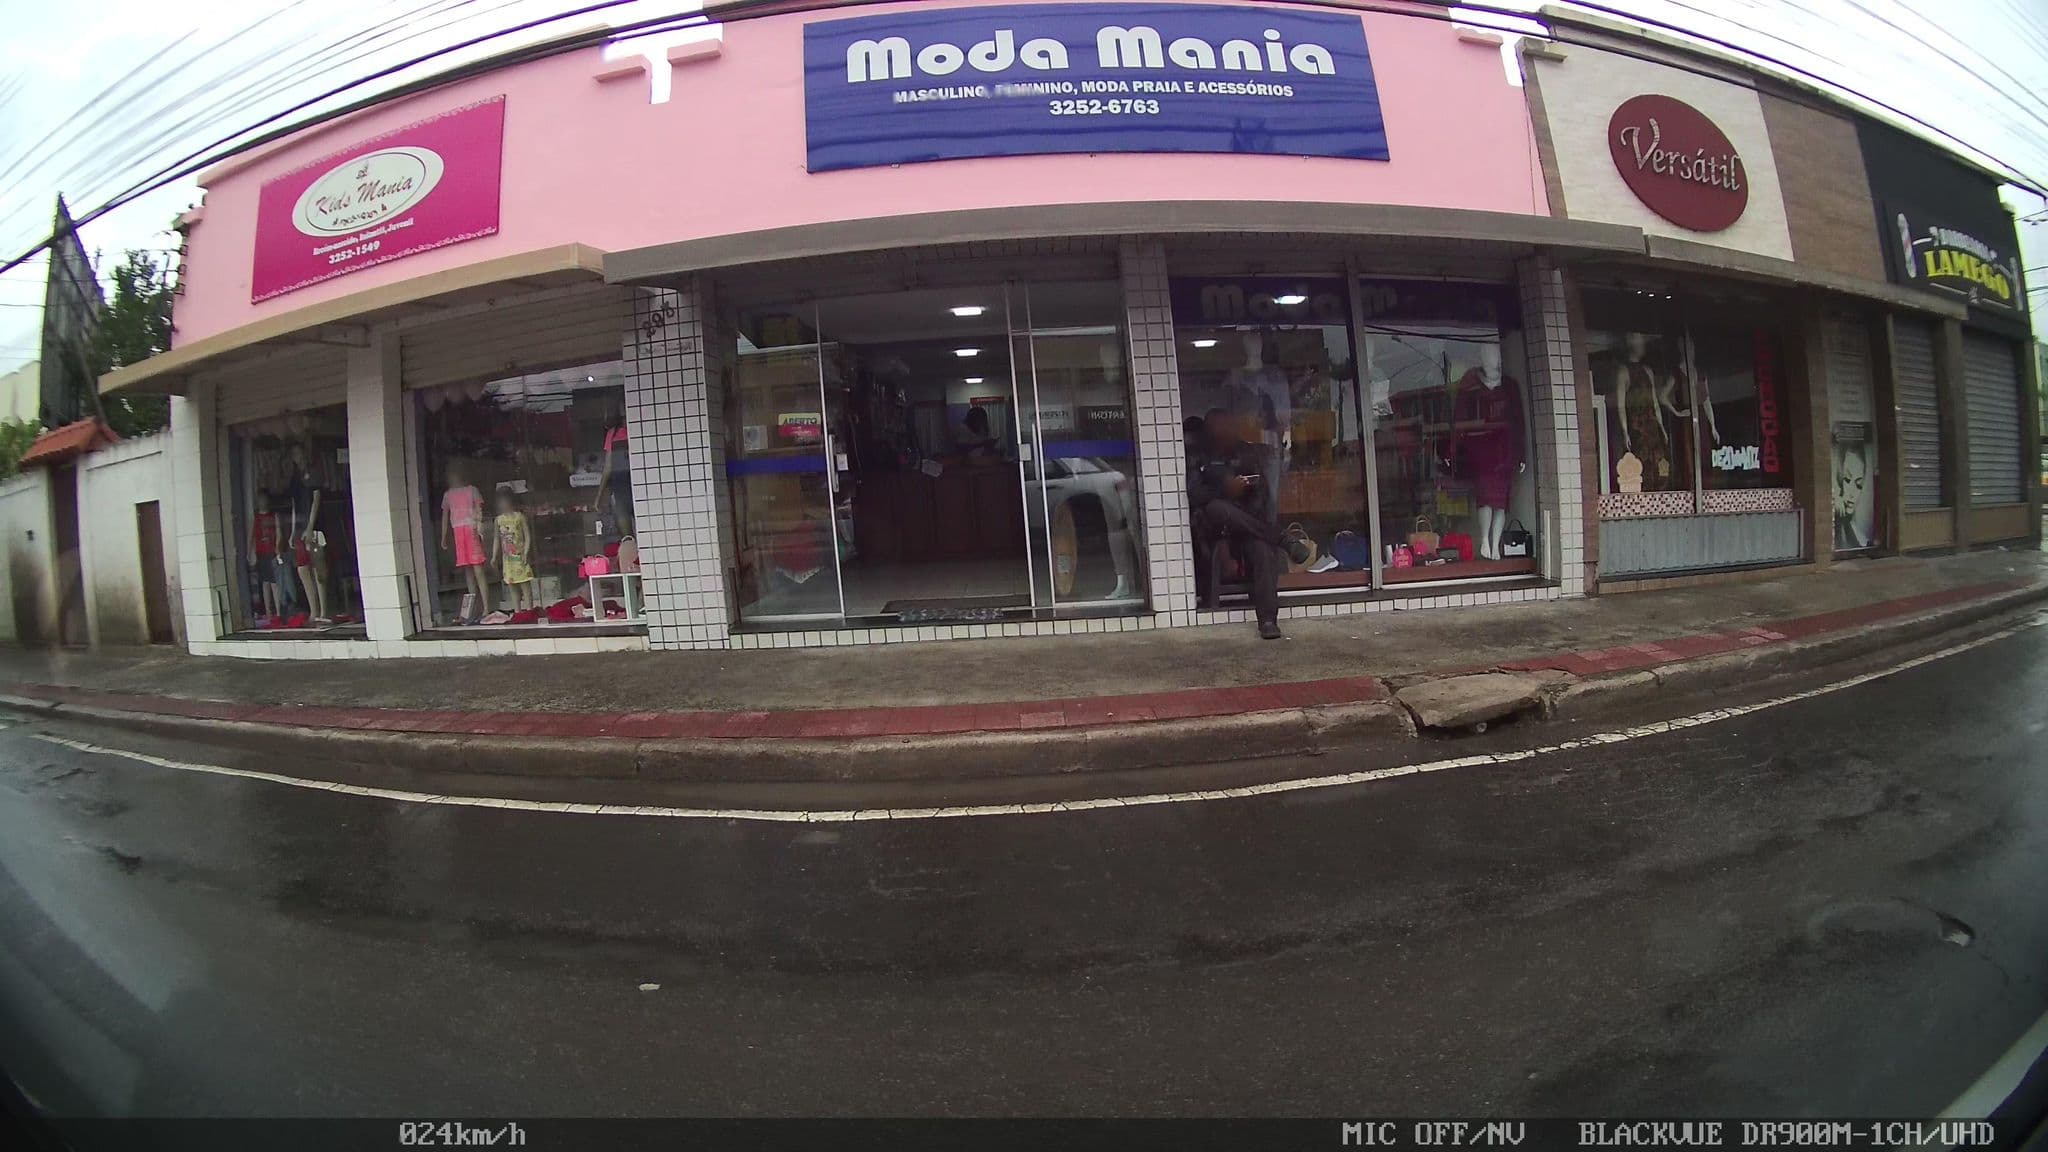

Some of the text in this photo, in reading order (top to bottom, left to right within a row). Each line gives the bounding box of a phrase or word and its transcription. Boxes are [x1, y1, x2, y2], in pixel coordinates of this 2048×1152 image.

[847, 25, 1336, 83] Moda Mania
[893, 85, 990, 104] MASCULINO,
[1081, 80, 1129, 94] MODA
[1132, 80, 1181, 94] PRAIA
[1184, 81, 1195, 93] E
[1198, 79, 1294, 98] ACESSÓRIOS
[1049, 99, 1160, 115] 3252-6763
[1620, 118, 1741, 191] Versátil
[357, 176, 413, 203] Mania
